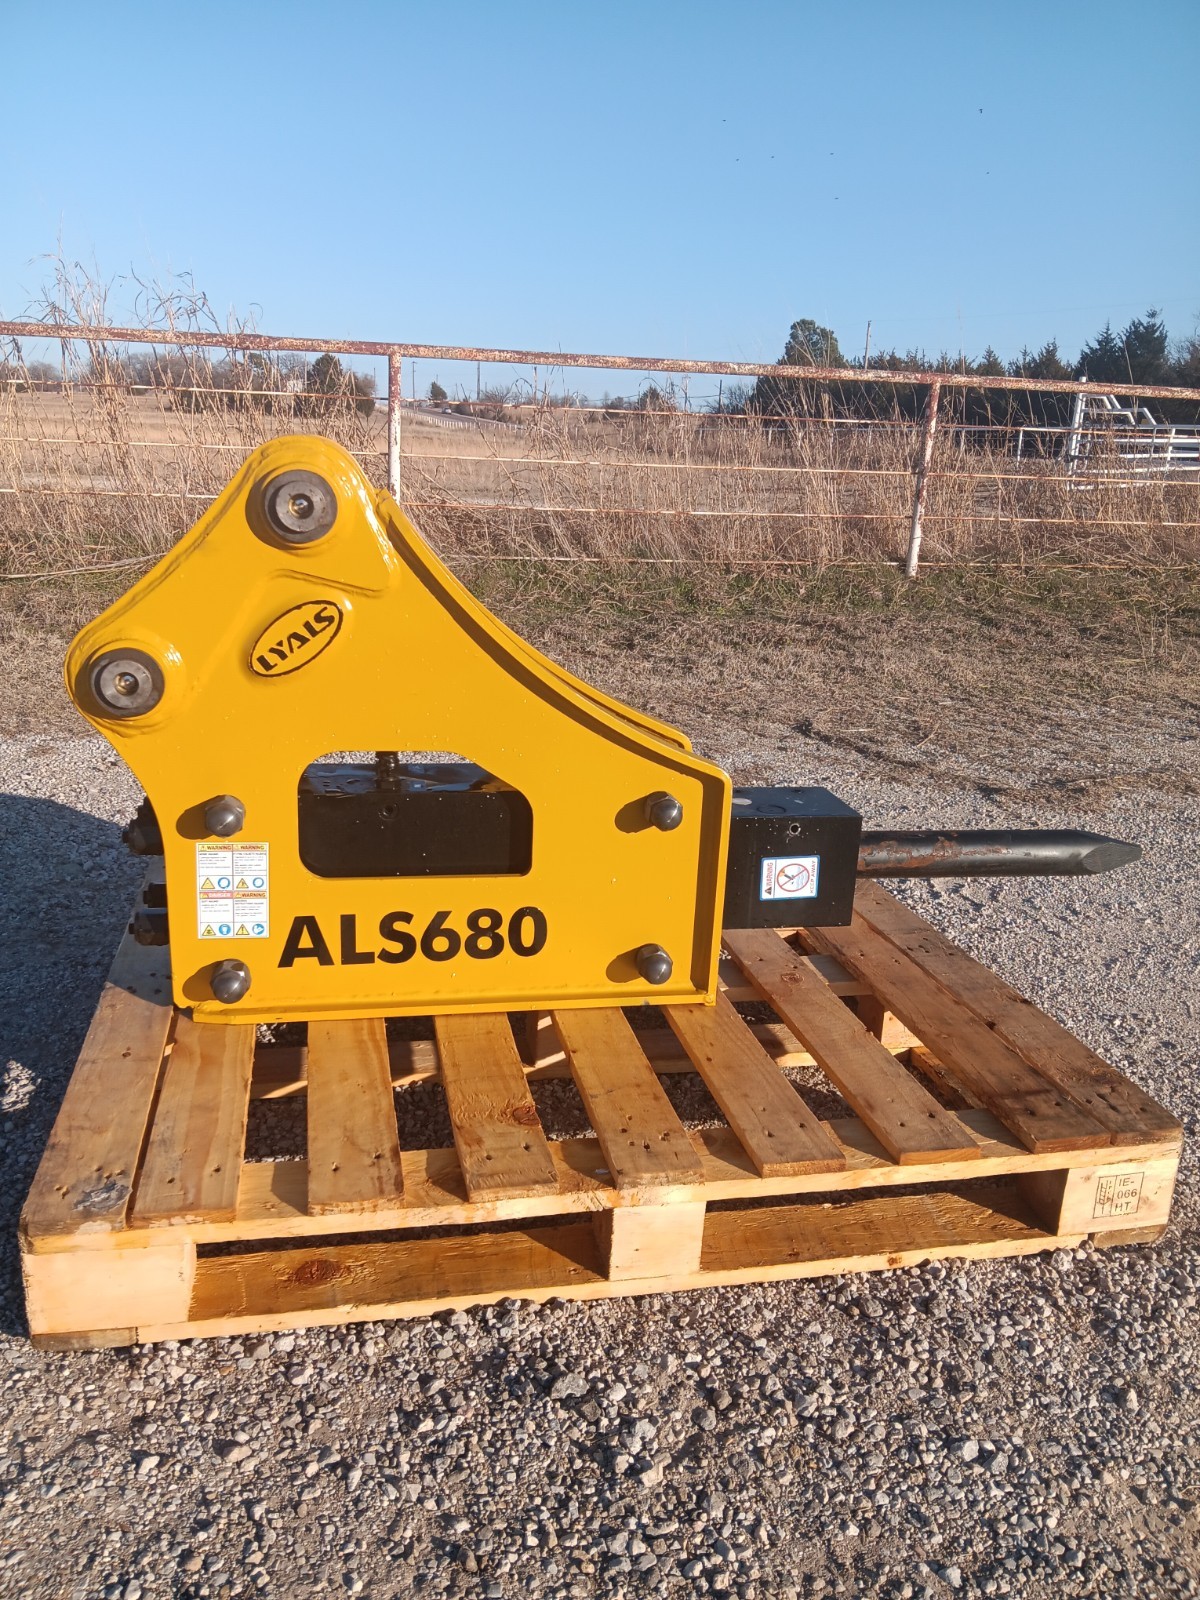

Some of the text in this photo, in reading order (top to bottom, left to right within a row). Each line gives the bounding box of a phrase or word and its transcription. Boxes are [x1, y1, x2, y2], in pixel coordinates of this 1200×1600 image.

[256, 606, 335, 672] LYALS
[766, 862, 774, 887] WARNING
[277, 906, 548, 968] ALS680
[1116, 1188, 1138, 1199] 066
[1114, 1201, 1132, 1212] HT
